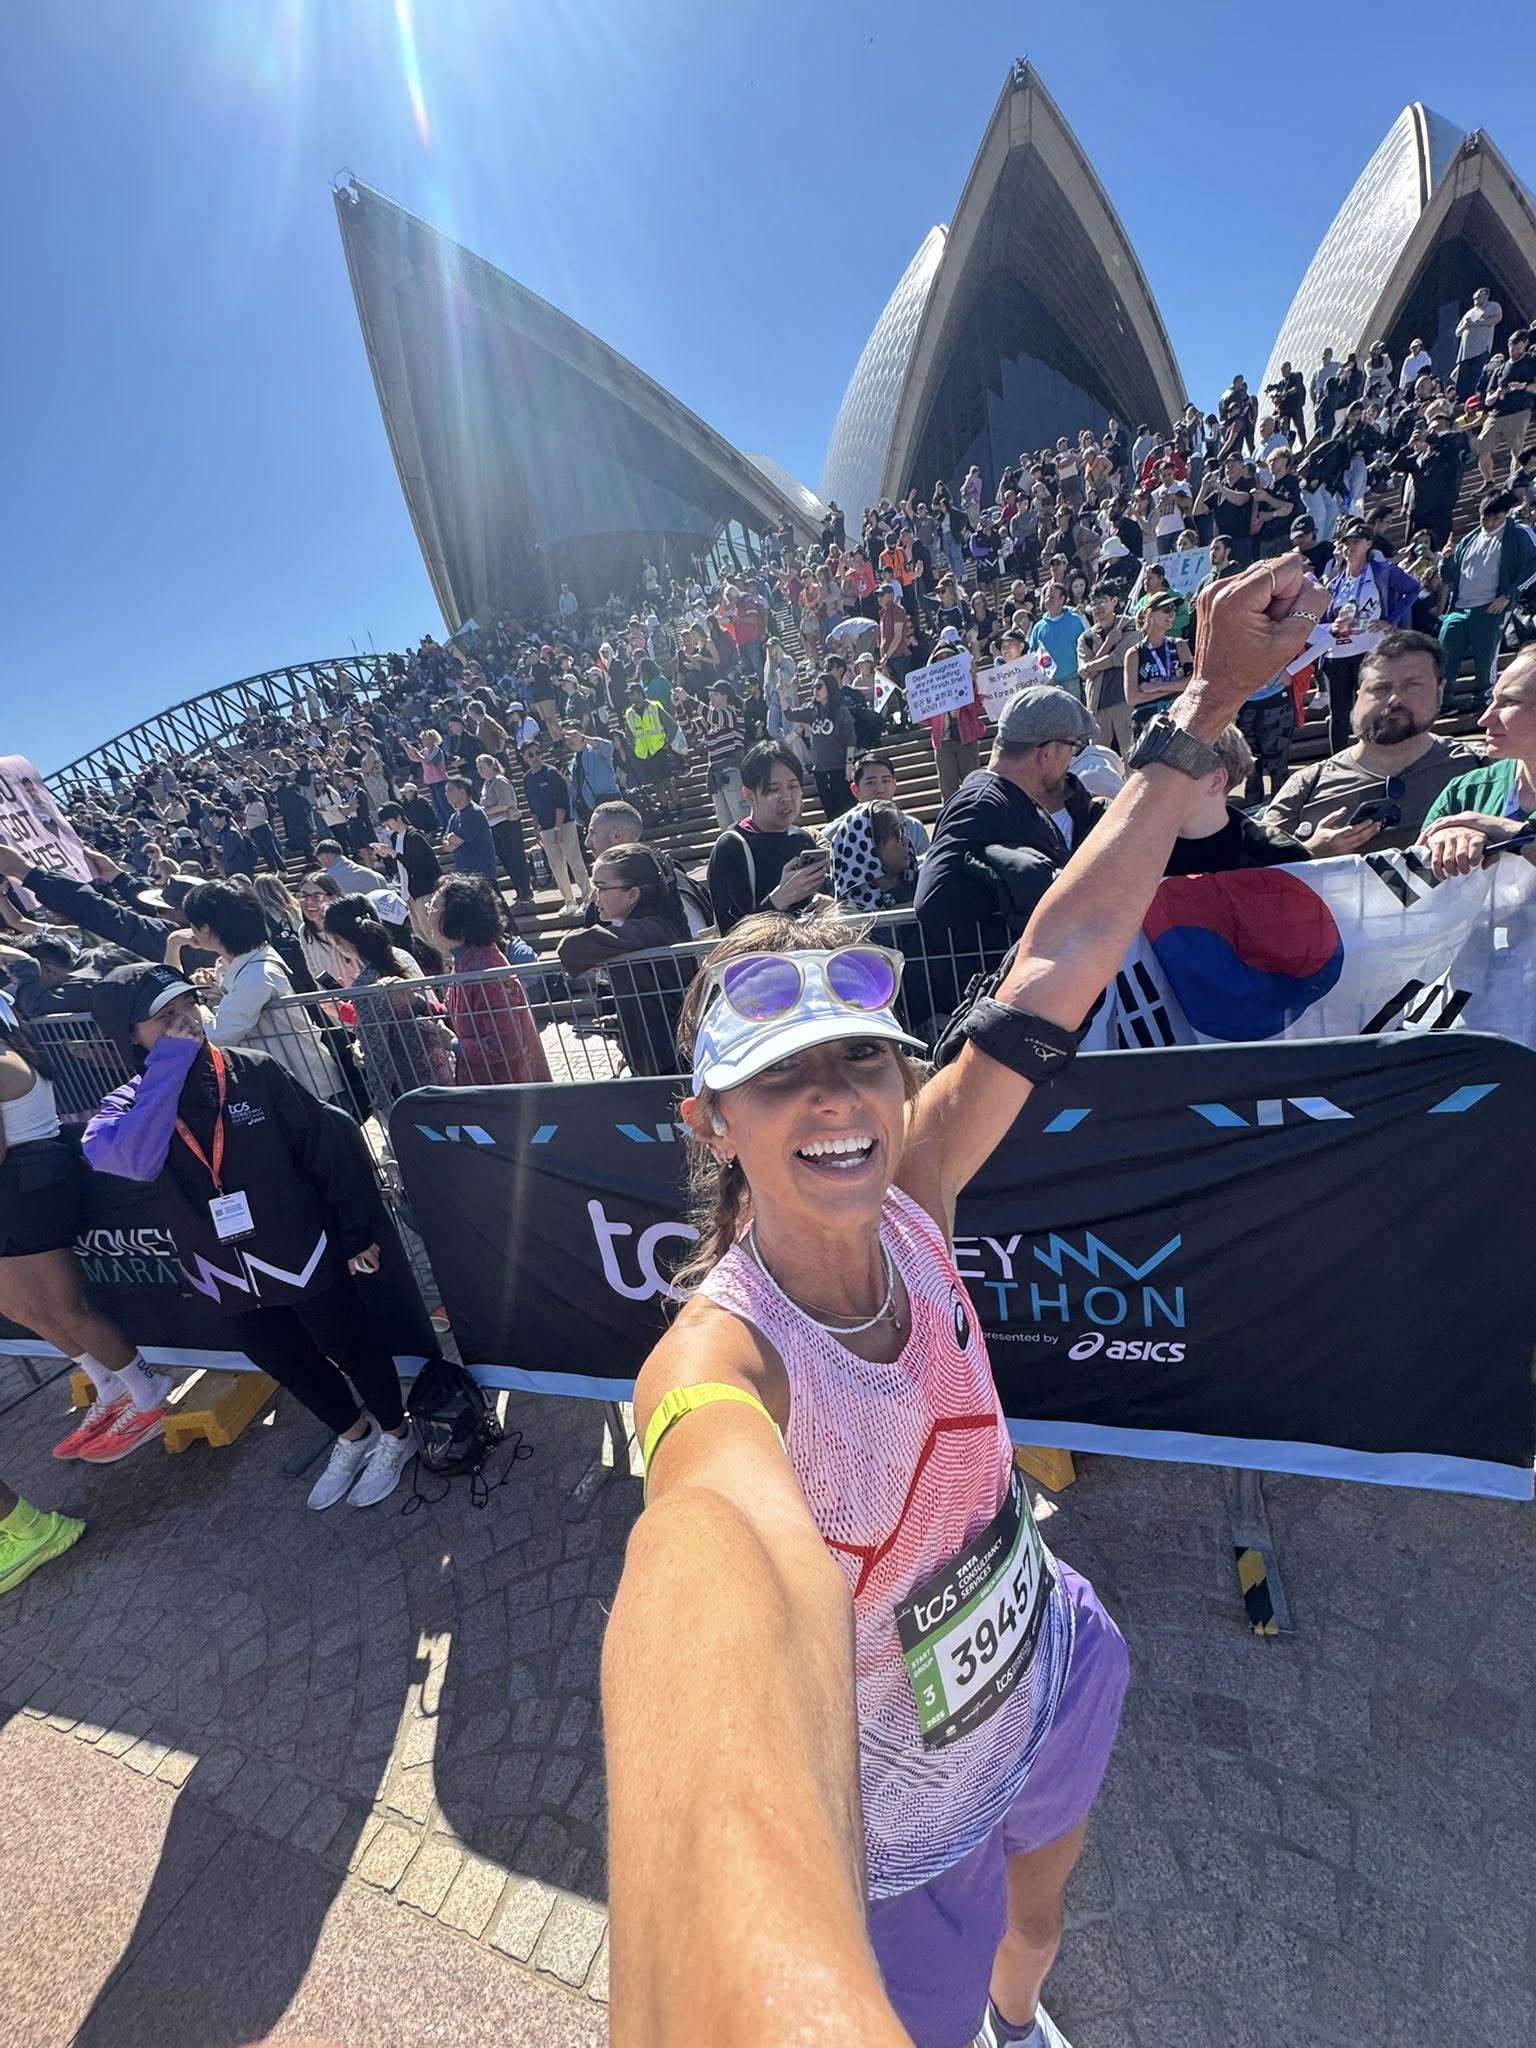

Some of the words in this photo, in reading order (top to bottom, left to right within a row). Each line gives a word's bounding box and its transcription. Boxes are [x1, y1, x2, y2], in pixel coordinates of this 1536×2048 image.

[997, 667, 1021, 680] Finish
[931, 681, 950, 692] finish
[228, 1101, 250, 1115] tcs
[587, 1199, 700, 1301] tc
[984, 1281, 1186, 1328] THON
[1043, 1333, 1060, 1345] by
[955, 1554, 979, 1579] TATA
[958, 1535, 1002, 1589] CONSULTANCY
[959, 1563, 992, 1600] SERVICES
[913, 1585, 957, 1633] tcs
[950, 1542, 1035, 1687] 39457
[911, 1647, 931, 1669] START
[913, 1656, 934, 1678] GROUP
[923, 1683, 936, 1707] 3
